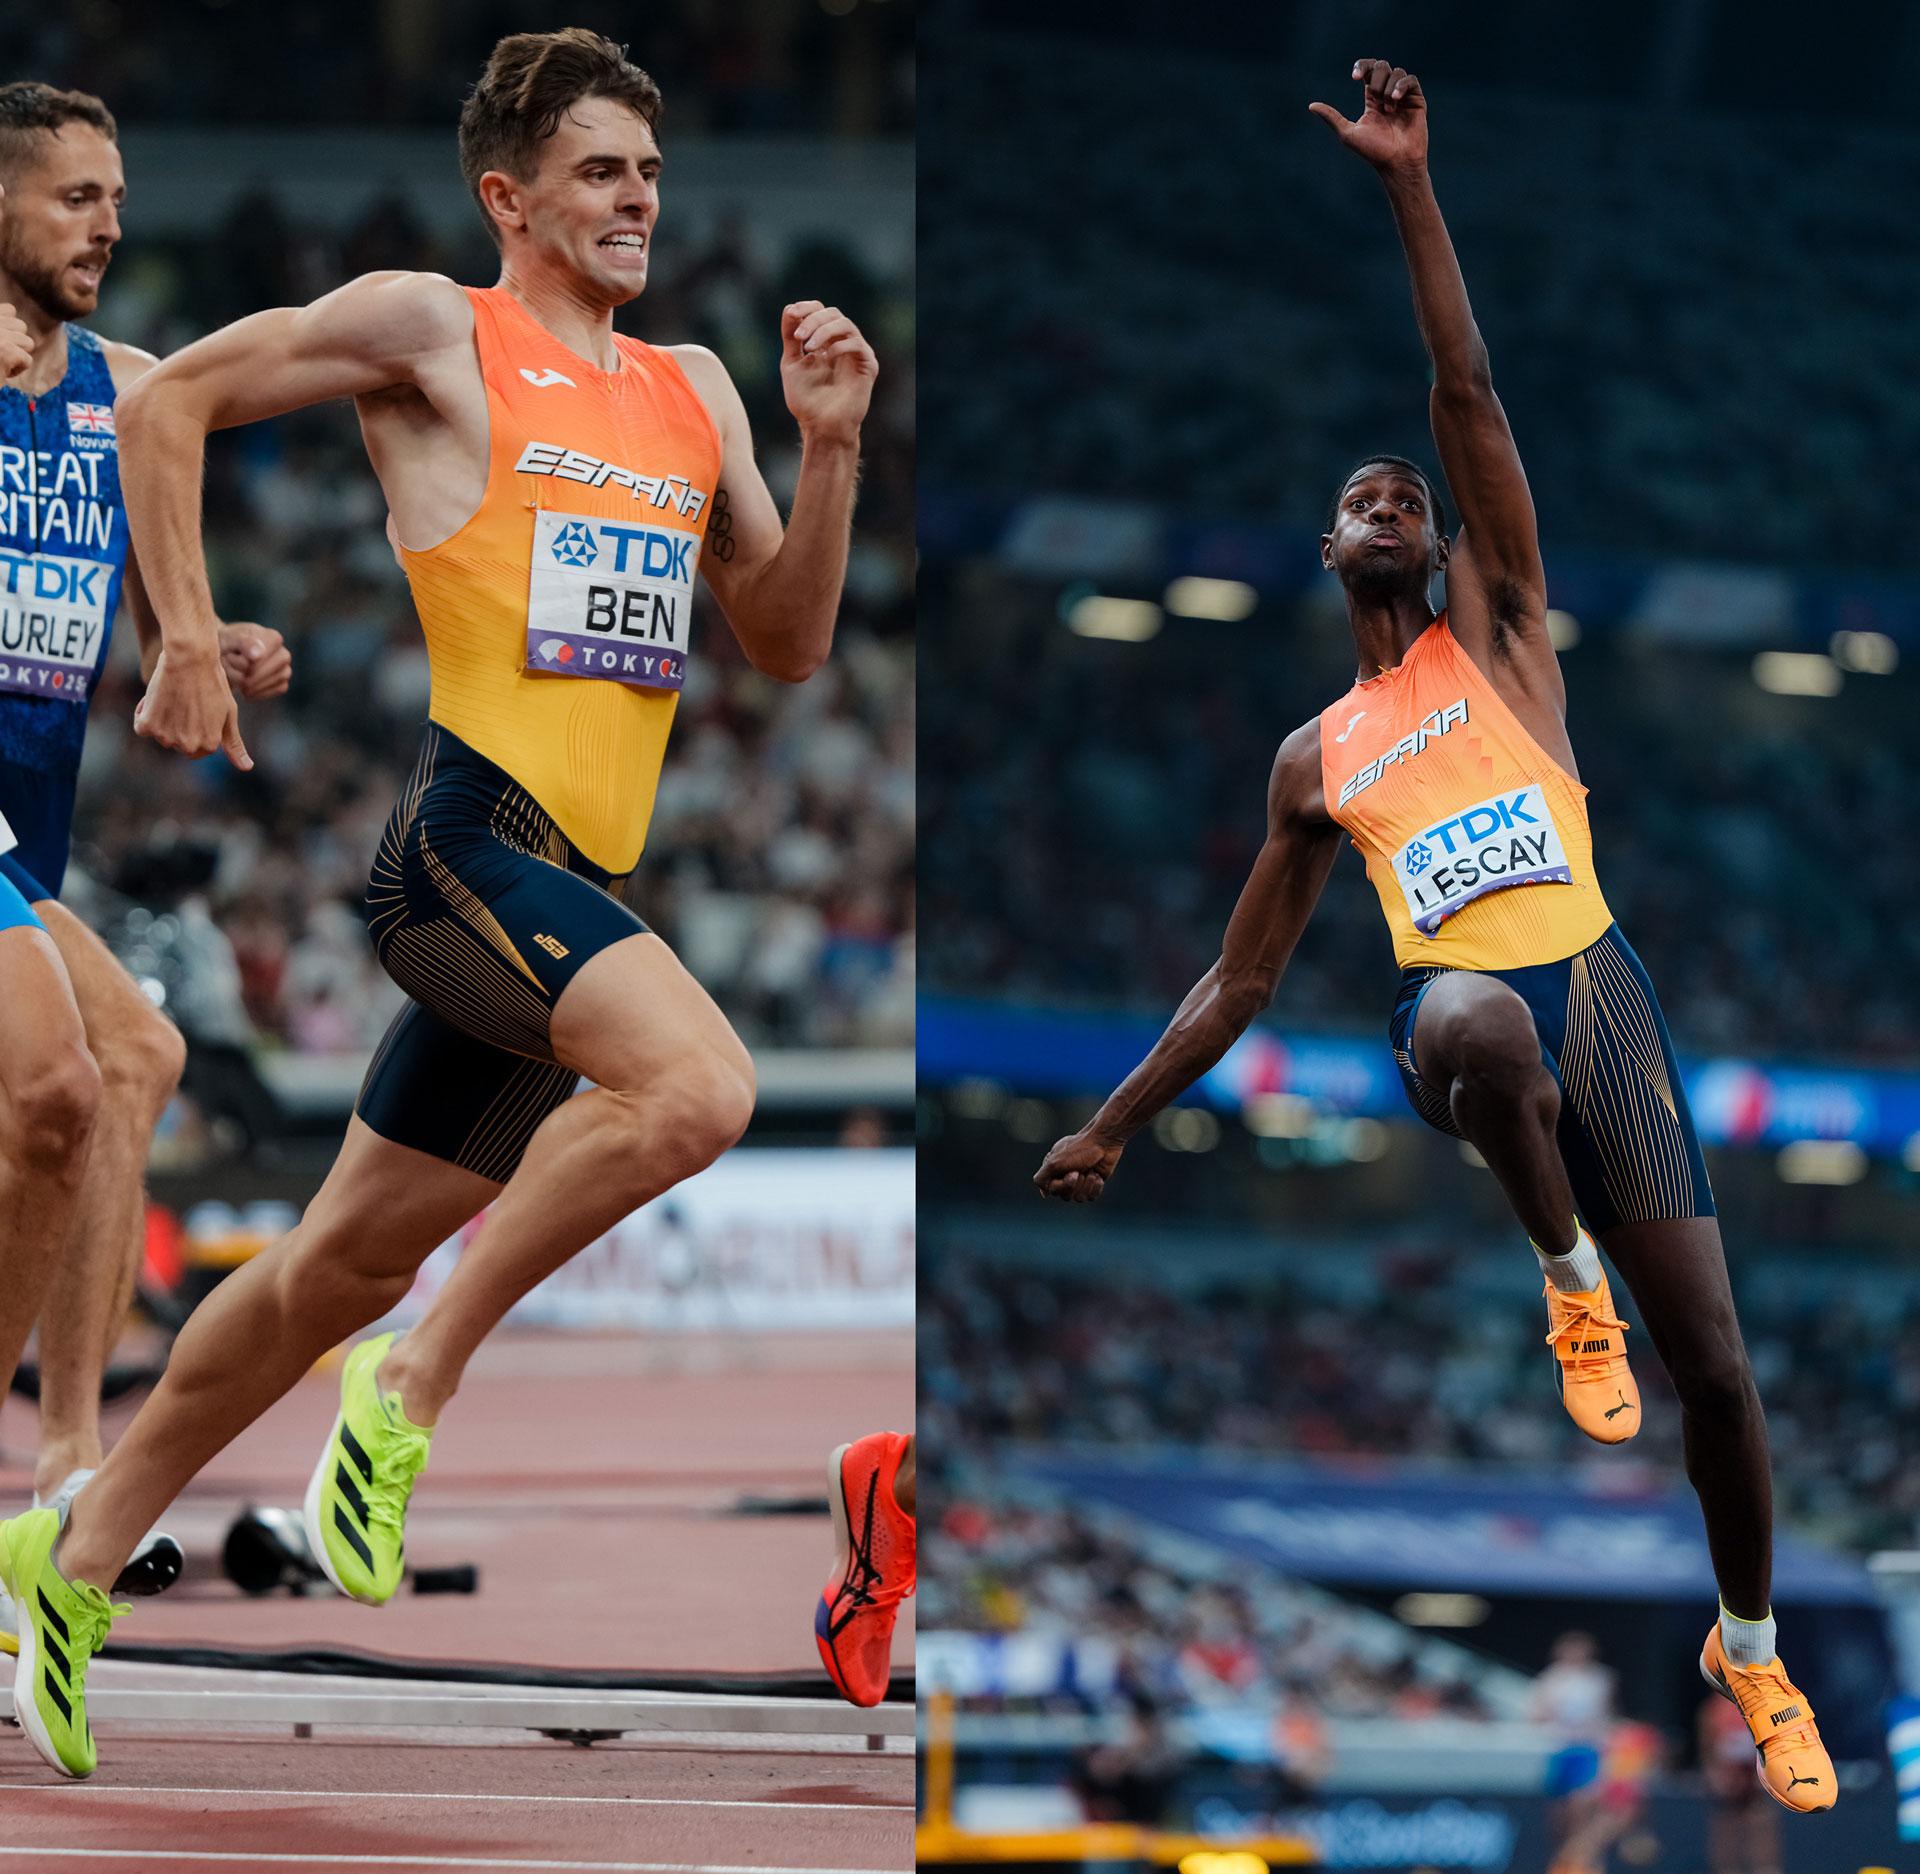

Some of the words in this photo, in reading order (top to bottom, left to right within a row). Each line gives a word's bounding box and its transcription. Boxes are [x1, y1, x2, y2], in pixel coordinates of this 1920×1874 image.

[514, 441, 708, 523] ESPAÑA
[0, 553, 99, 607] TDK
[600, 525, 692, 584] TDK
[2, 608, 98, 660] URLEY
[585, 585, 675, 643] BEN
[1338, 697, 1470, 811] ESPAÑA
[1425, 792, 1538, 855] TDK
[1413, 831, 1548, 913] LESCAY
